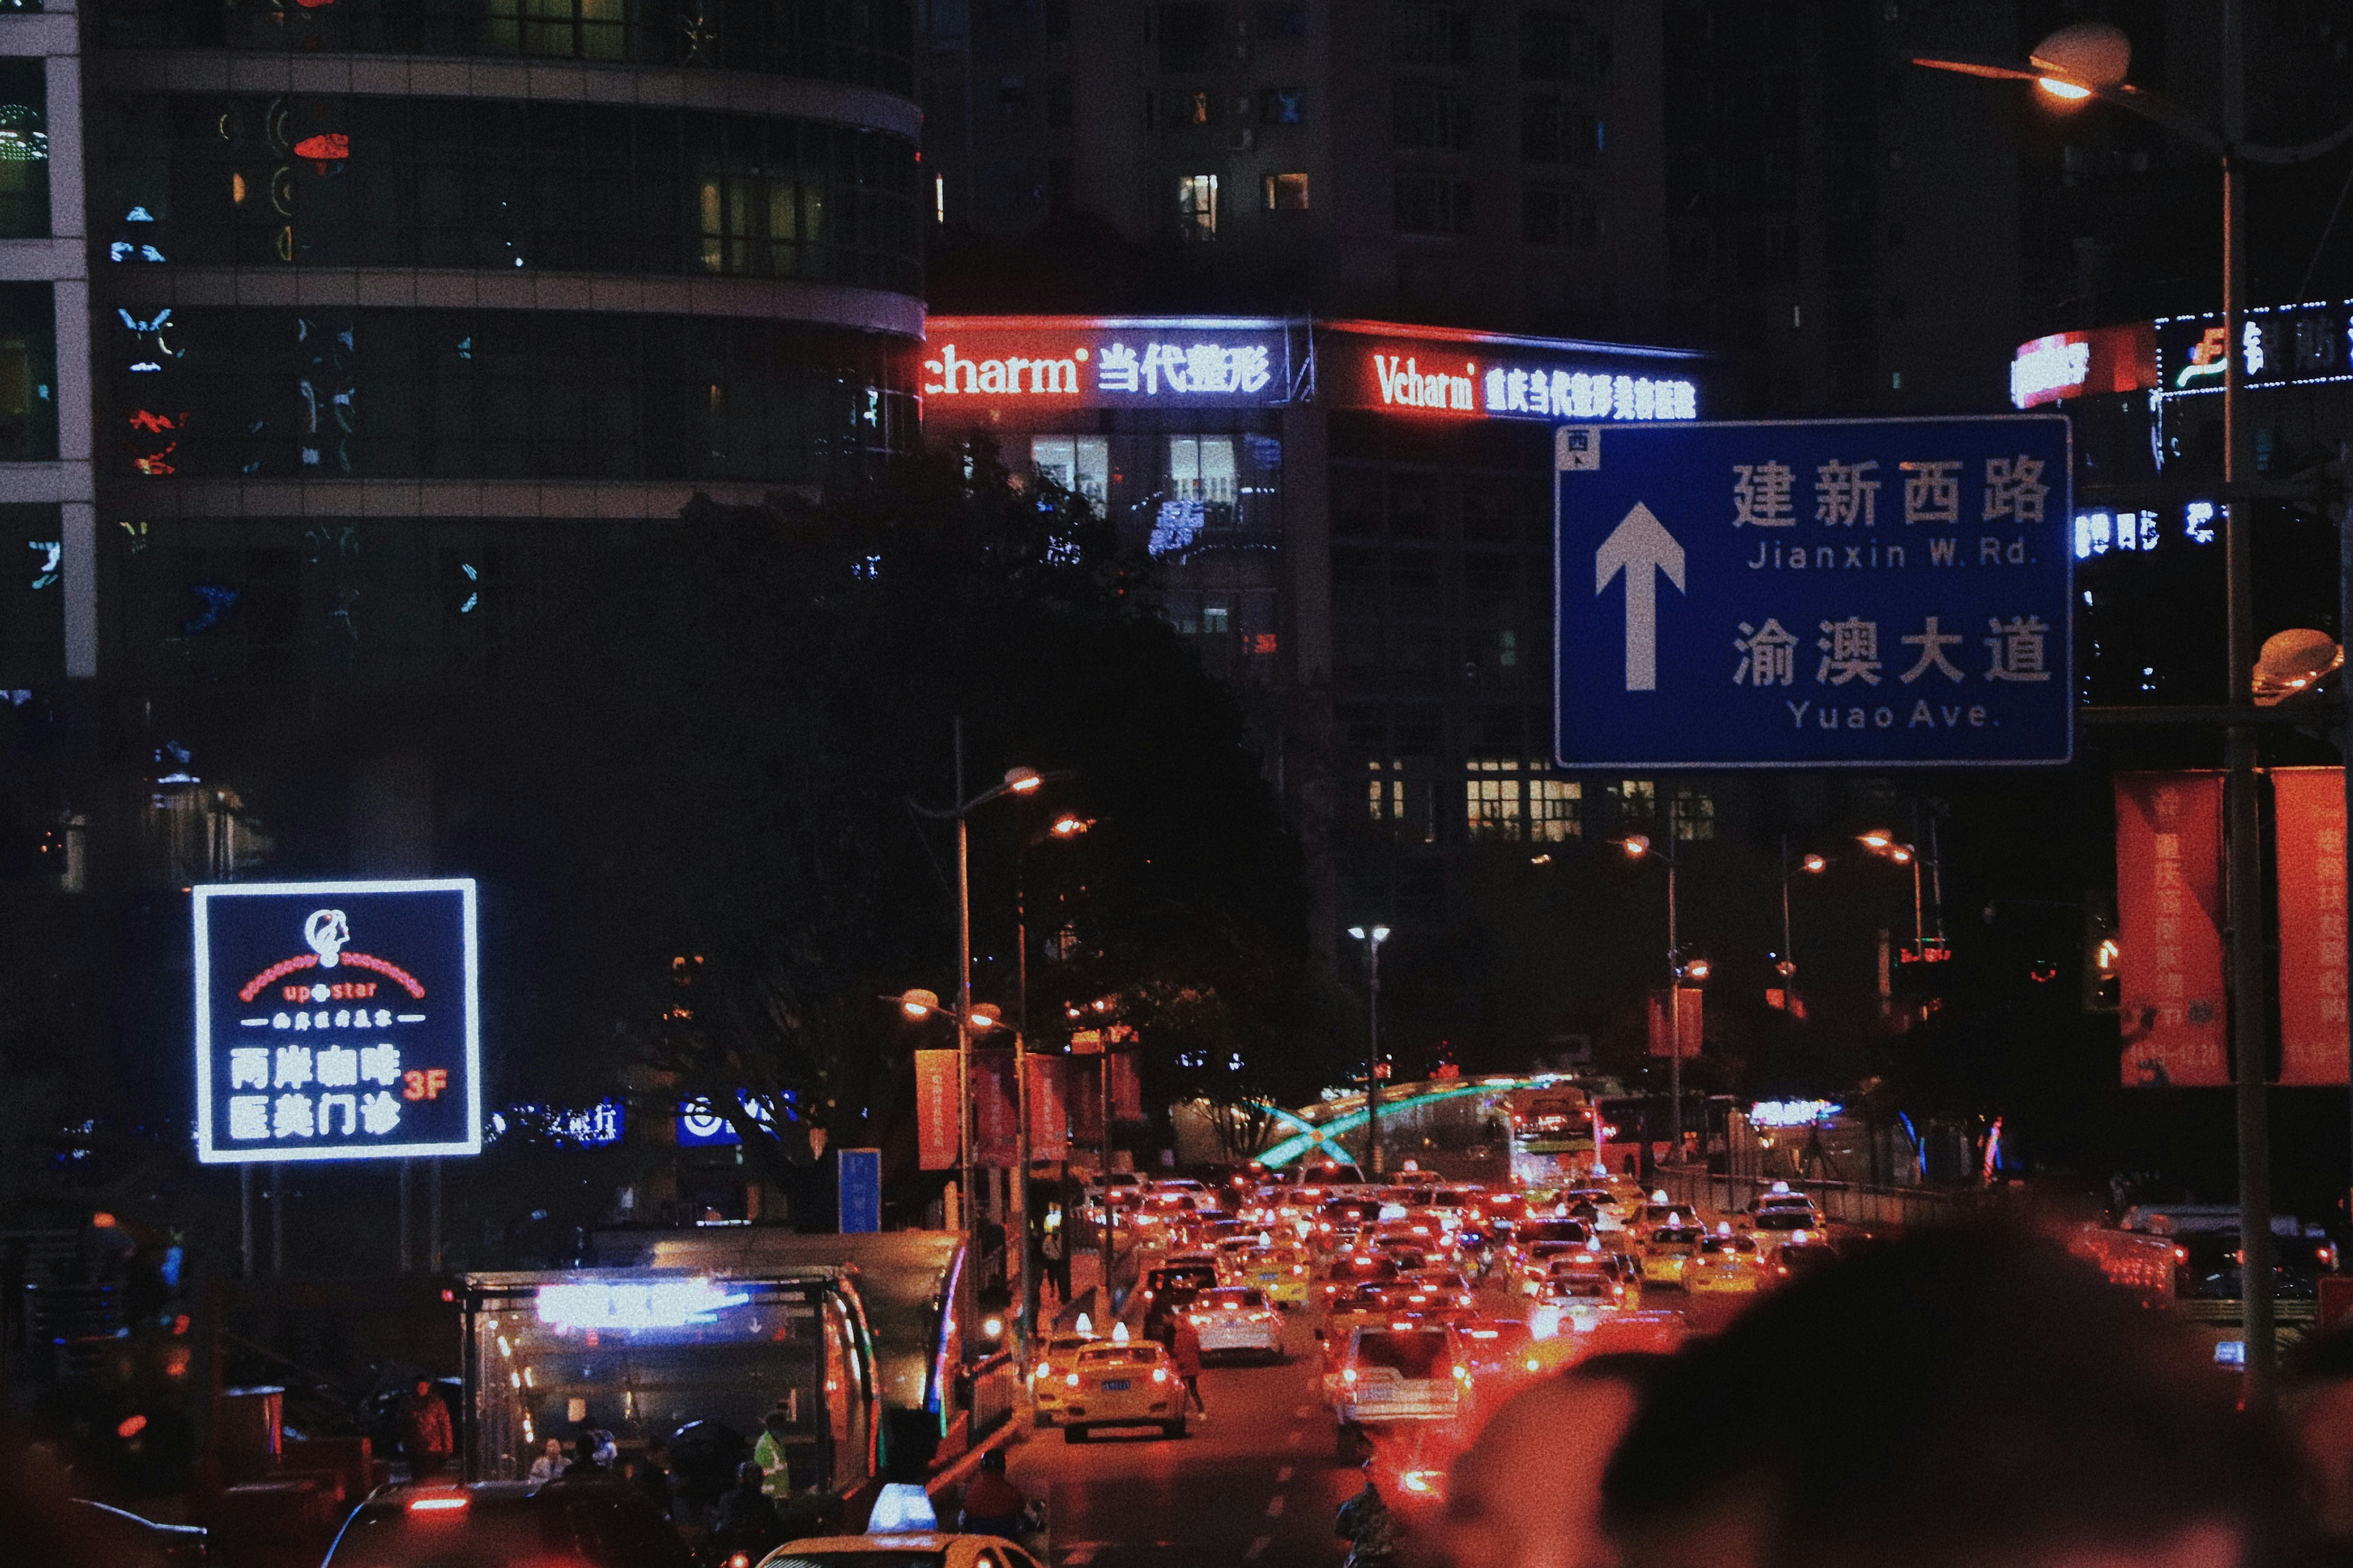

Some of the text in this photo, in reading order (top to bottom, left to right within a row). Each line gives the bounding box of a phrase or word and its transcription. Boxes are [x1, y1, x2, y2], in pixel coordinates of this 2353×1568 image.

[1098, 343, 1271, 395] 当代整形
[1732, 455, 2050, 528] 建新西路
[1748, 537, 2038, 570] Jianxin W. Rd.
[1733, 616, 2052, 687] 渝澳大道
[1787, 700, 2001, 729] Yuao Ave.
[403, 1069, 448, 1101] 3F
